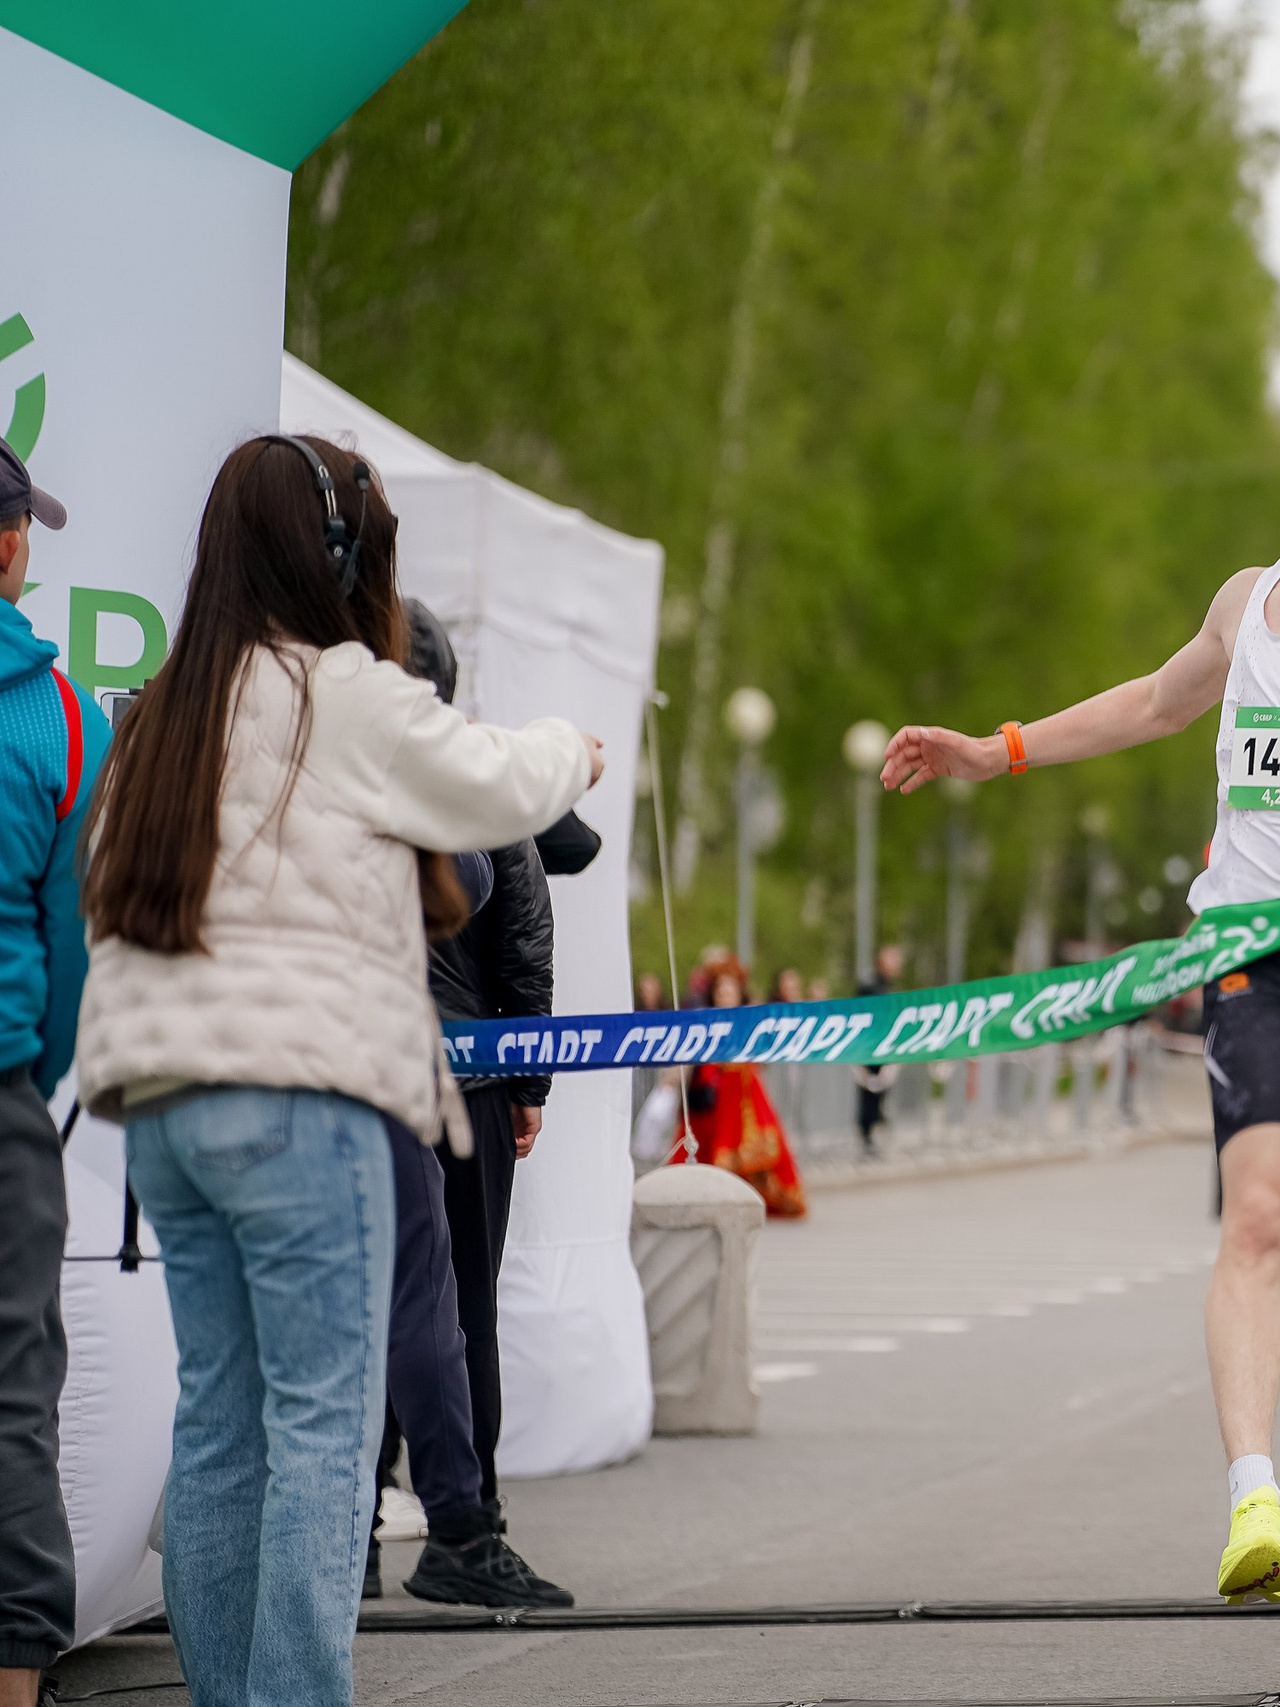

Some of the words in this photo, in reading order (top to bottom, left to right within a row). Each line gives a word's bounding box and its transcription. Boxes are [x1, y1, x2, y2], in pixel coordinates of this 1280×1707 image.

[496, 1029, 602, 1064] СТАРТ
[613, 1021, 733, 1063] СТАРТ
[732, 1012, 873, 1063] СТАРТ
[872, 991, 1014, 1058] СТАРТ
